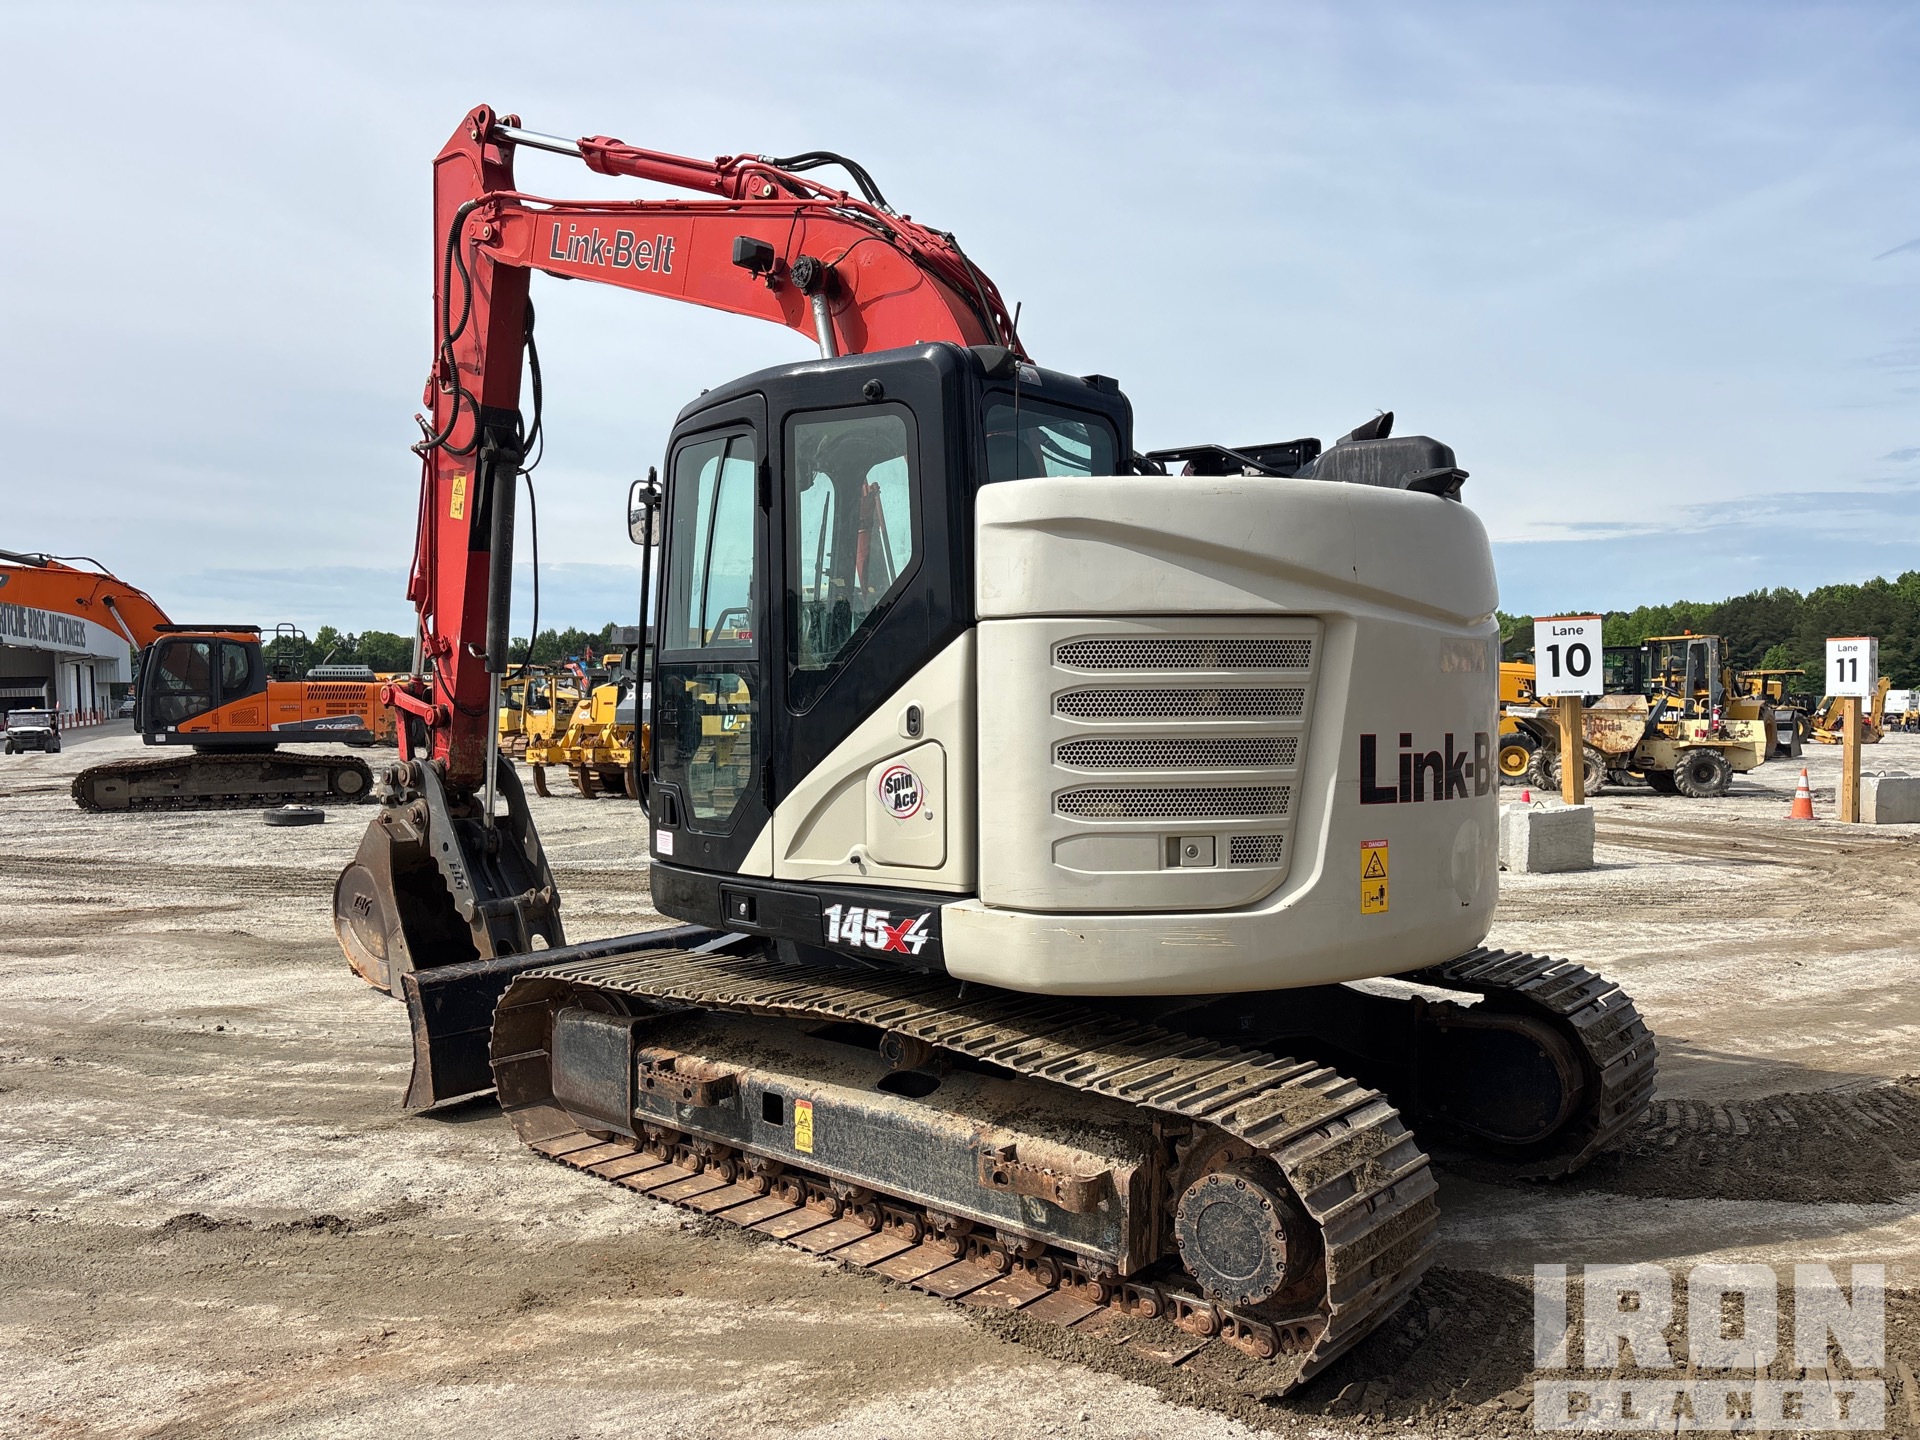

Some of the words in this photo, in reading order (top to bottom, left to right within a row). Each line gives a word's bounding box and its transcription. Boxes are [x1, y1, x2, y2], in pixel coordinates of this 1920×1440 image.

[550, 222, 676, 275] Link-Belt
[28, 608, 48, 642] BROS.
[1552, 626, 1584, 636] Lane
[1837, 644, 1858, 652] Lane
[1546, 642, 1592, 678] 10
[1836, 657, 1857, 683] 11
[723, 715, 745, 730] CA
[886, 773, 912, 794] Spin
[894, 791, 918, 810] Ace
